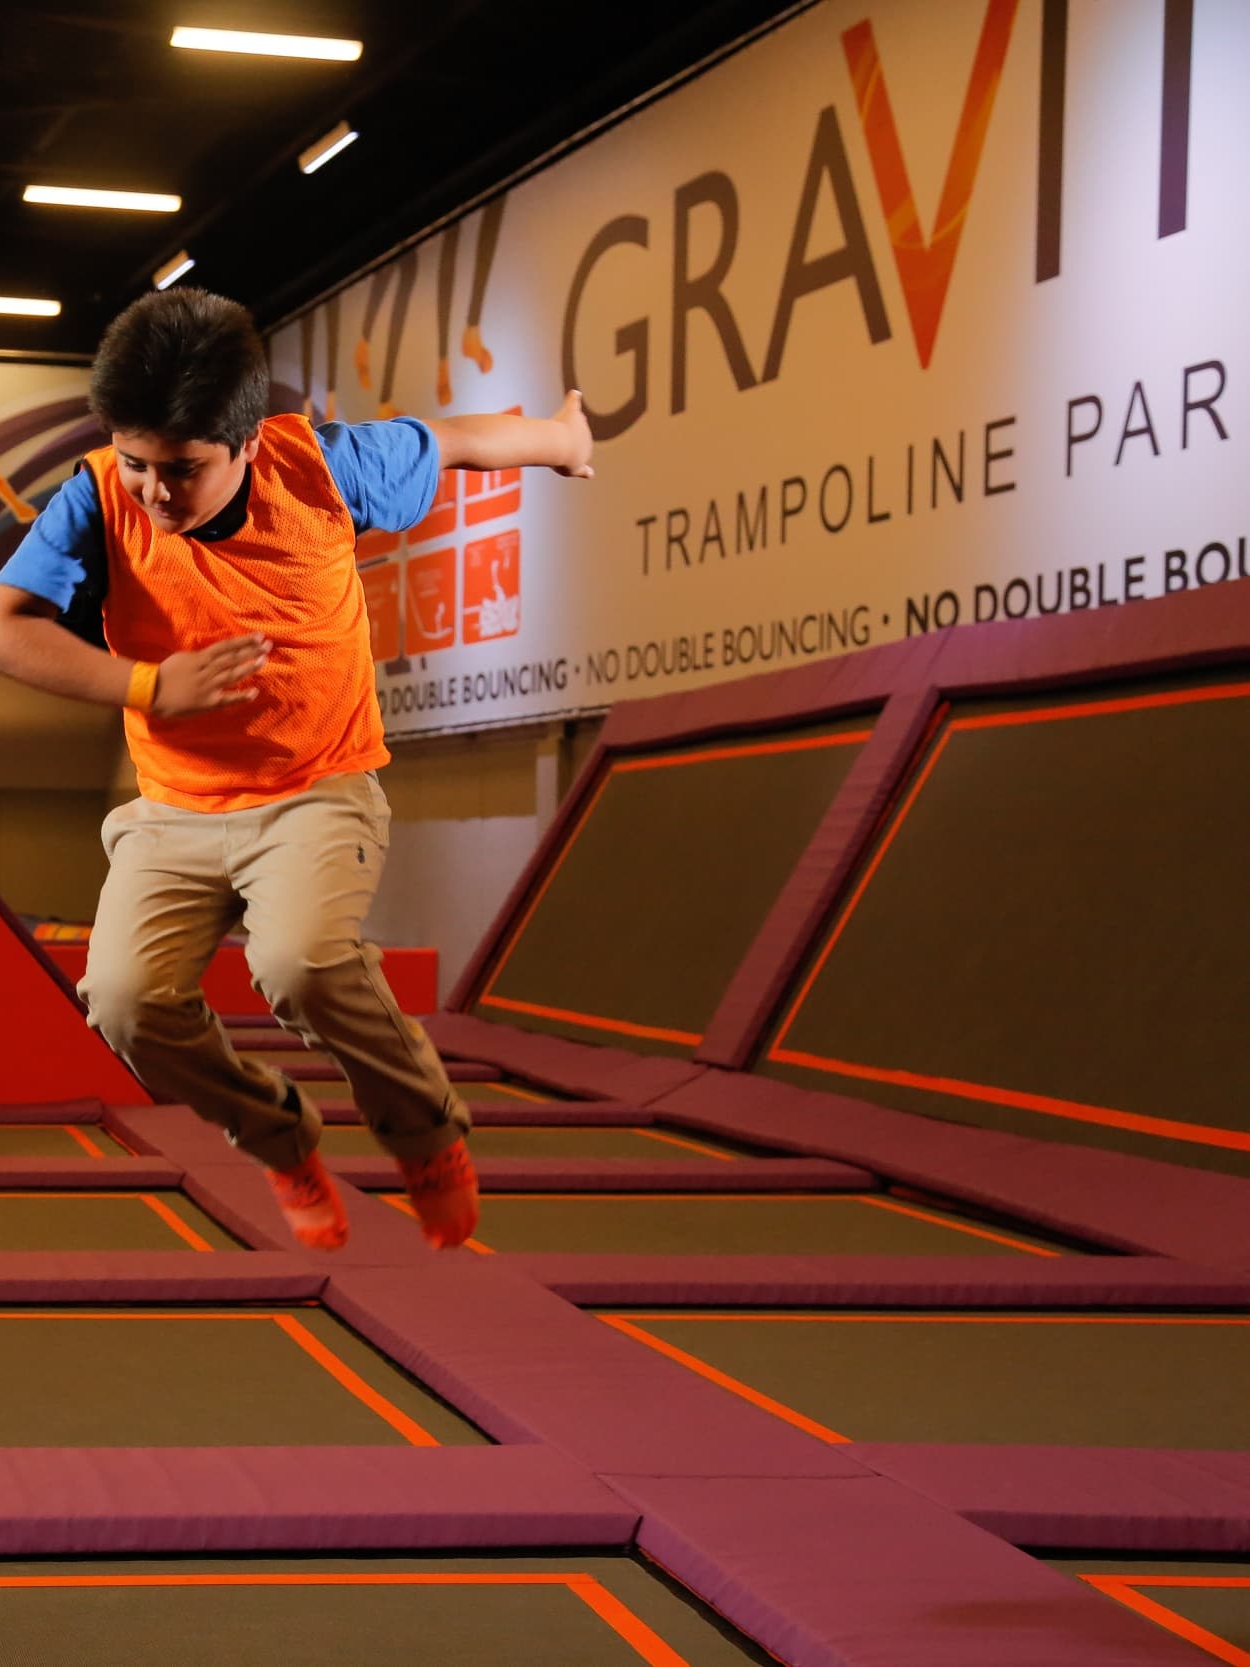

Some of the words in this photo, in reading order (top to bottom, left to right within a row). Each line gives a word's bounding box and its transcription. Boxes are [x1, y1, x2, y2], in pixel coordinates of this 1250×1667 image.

[635, 415, 1018, 577] TRAMPOLINE
[1064, 359, 1229, 478] PAR
[391, 676, 457, 716] DOUBLE
[462, 657, 569, 705] BOUNCING
[586, 647, 621, 686] NO
[626, 631, 715, 681] DOUBLE
[722, 604, 871, 668] BOUNCING
[905, 589, 960, 640] NO
[974, 555, 1146, 625] DOUBLE
